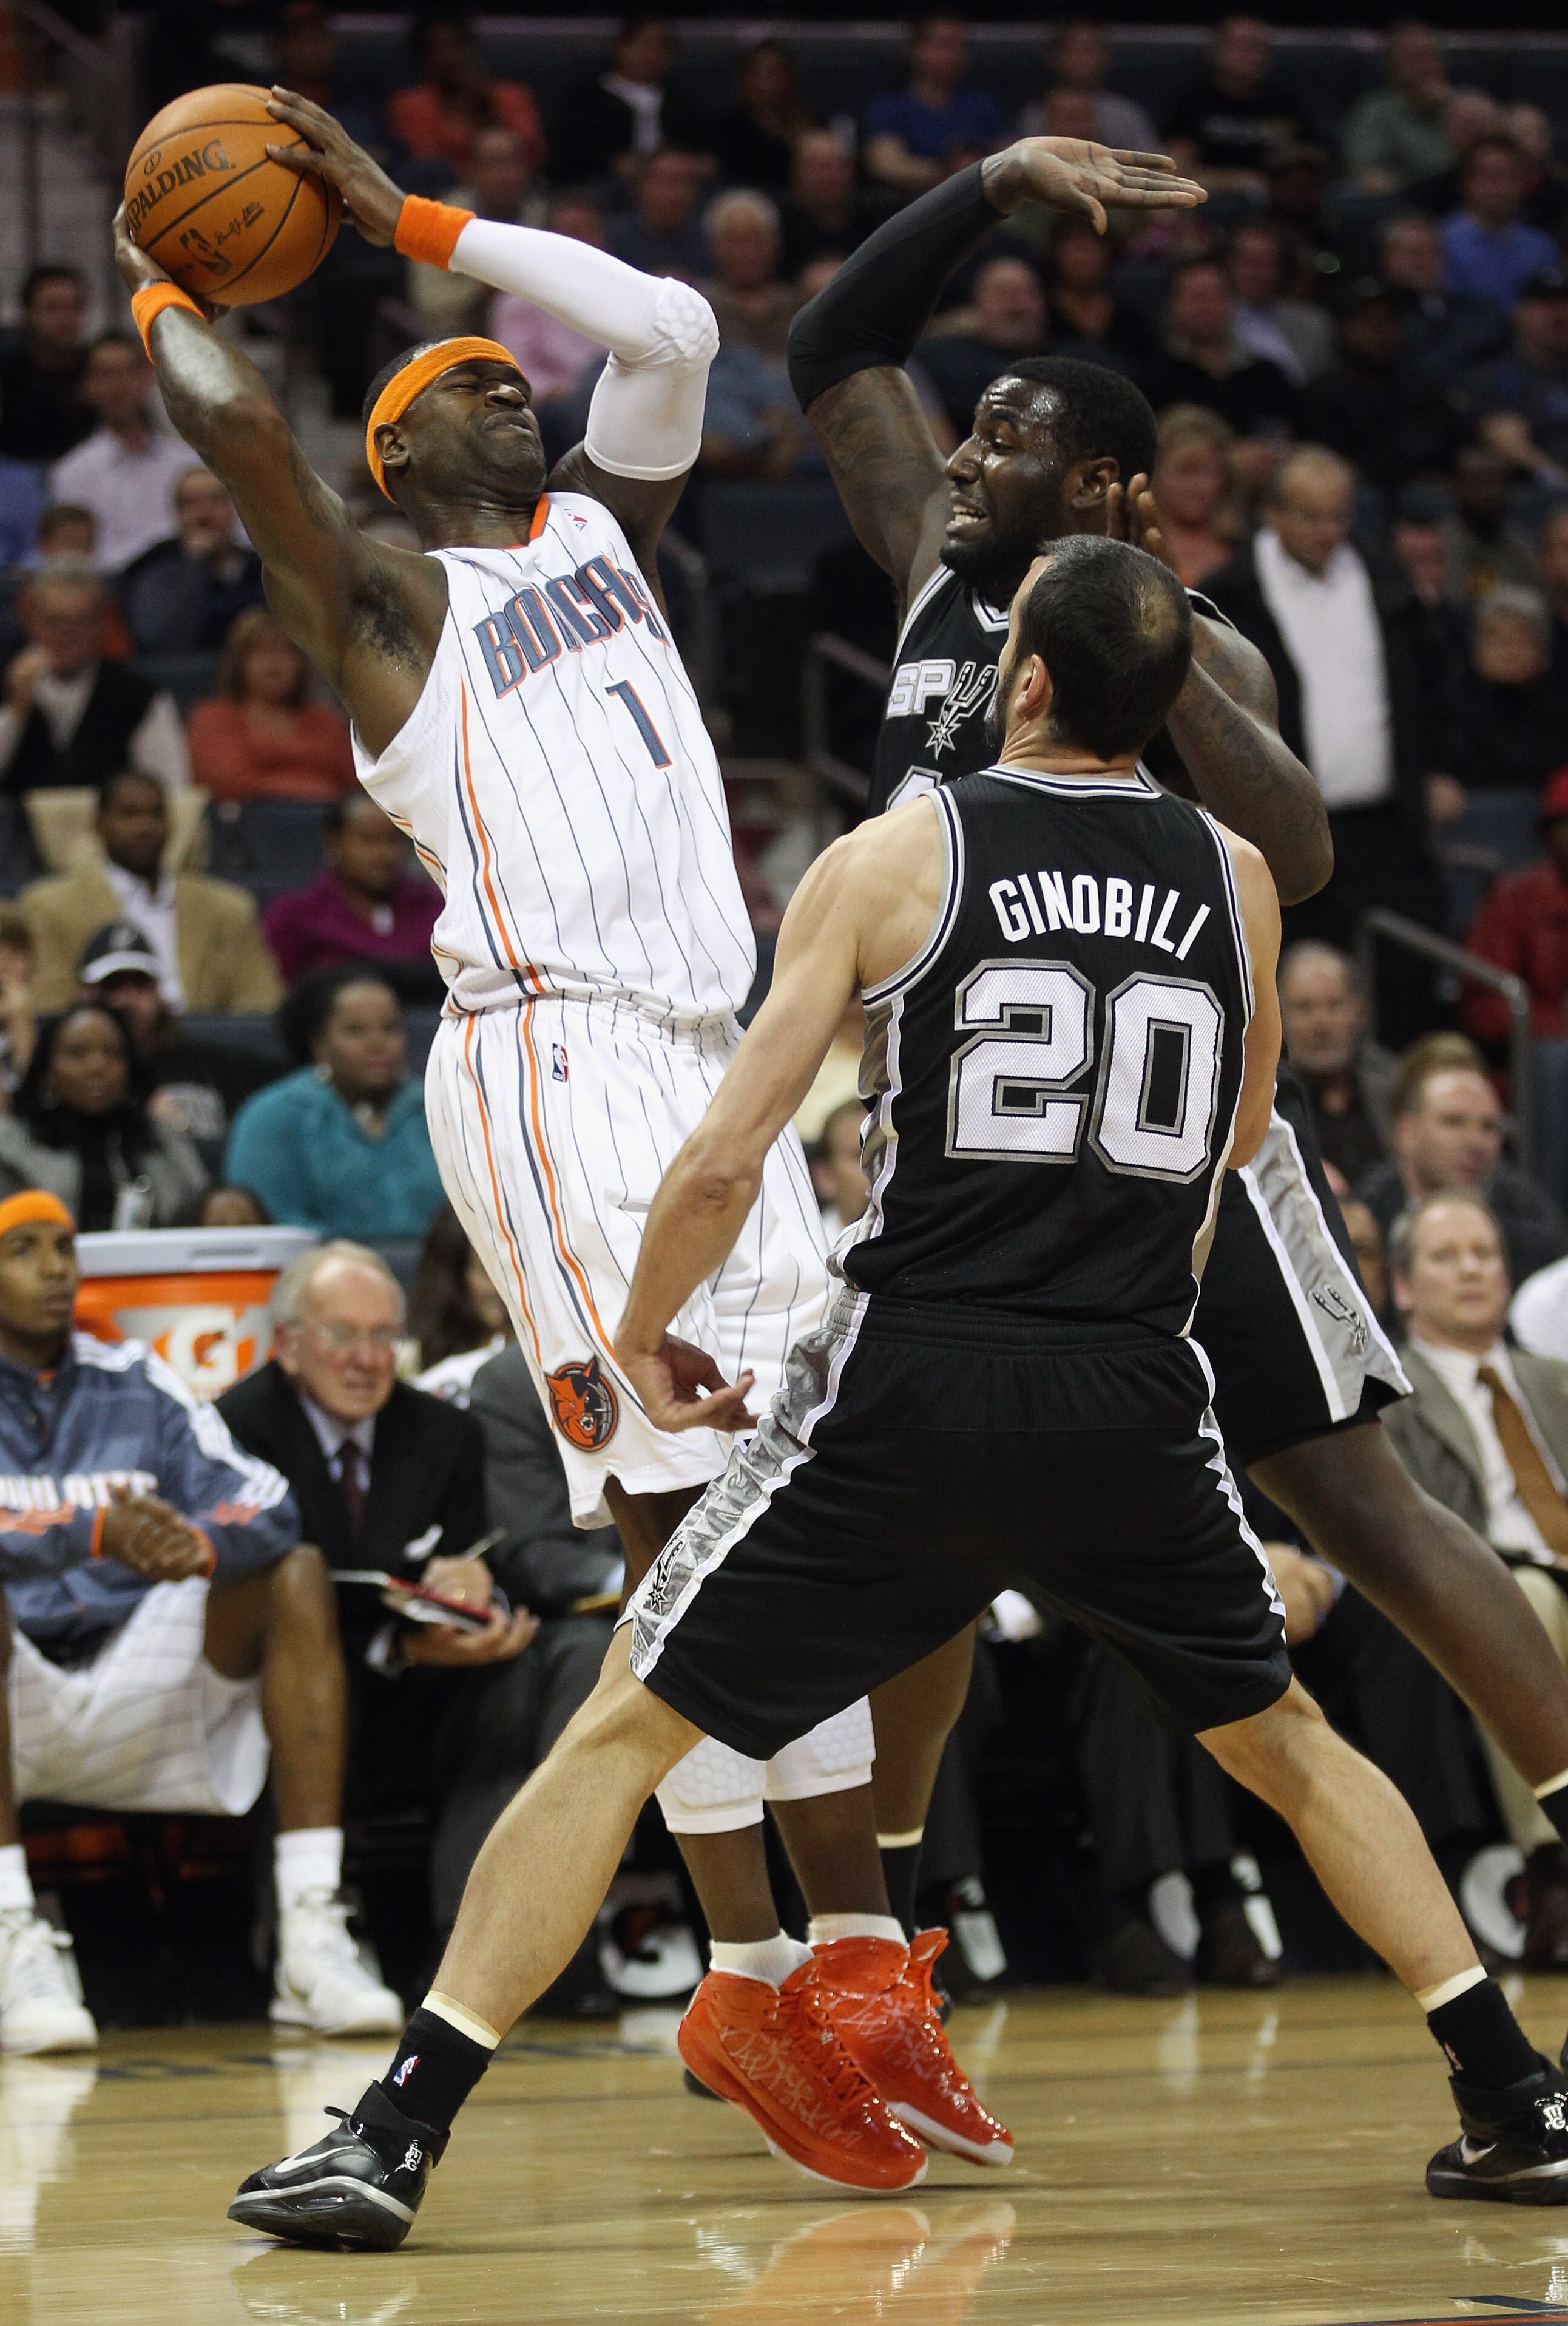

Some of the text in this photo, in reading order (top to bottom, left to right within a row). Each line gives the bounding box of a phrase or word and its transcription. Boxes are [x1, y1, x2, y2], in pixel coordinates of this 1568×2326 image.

[604, 680, 672, 768] 1
[887, 659, 1000, 753] SPU
[988, 871, 1211, 960] GINOBILI
[945, 959, 1224, 1184] 20
[172, 1308, 235, 1388] G
